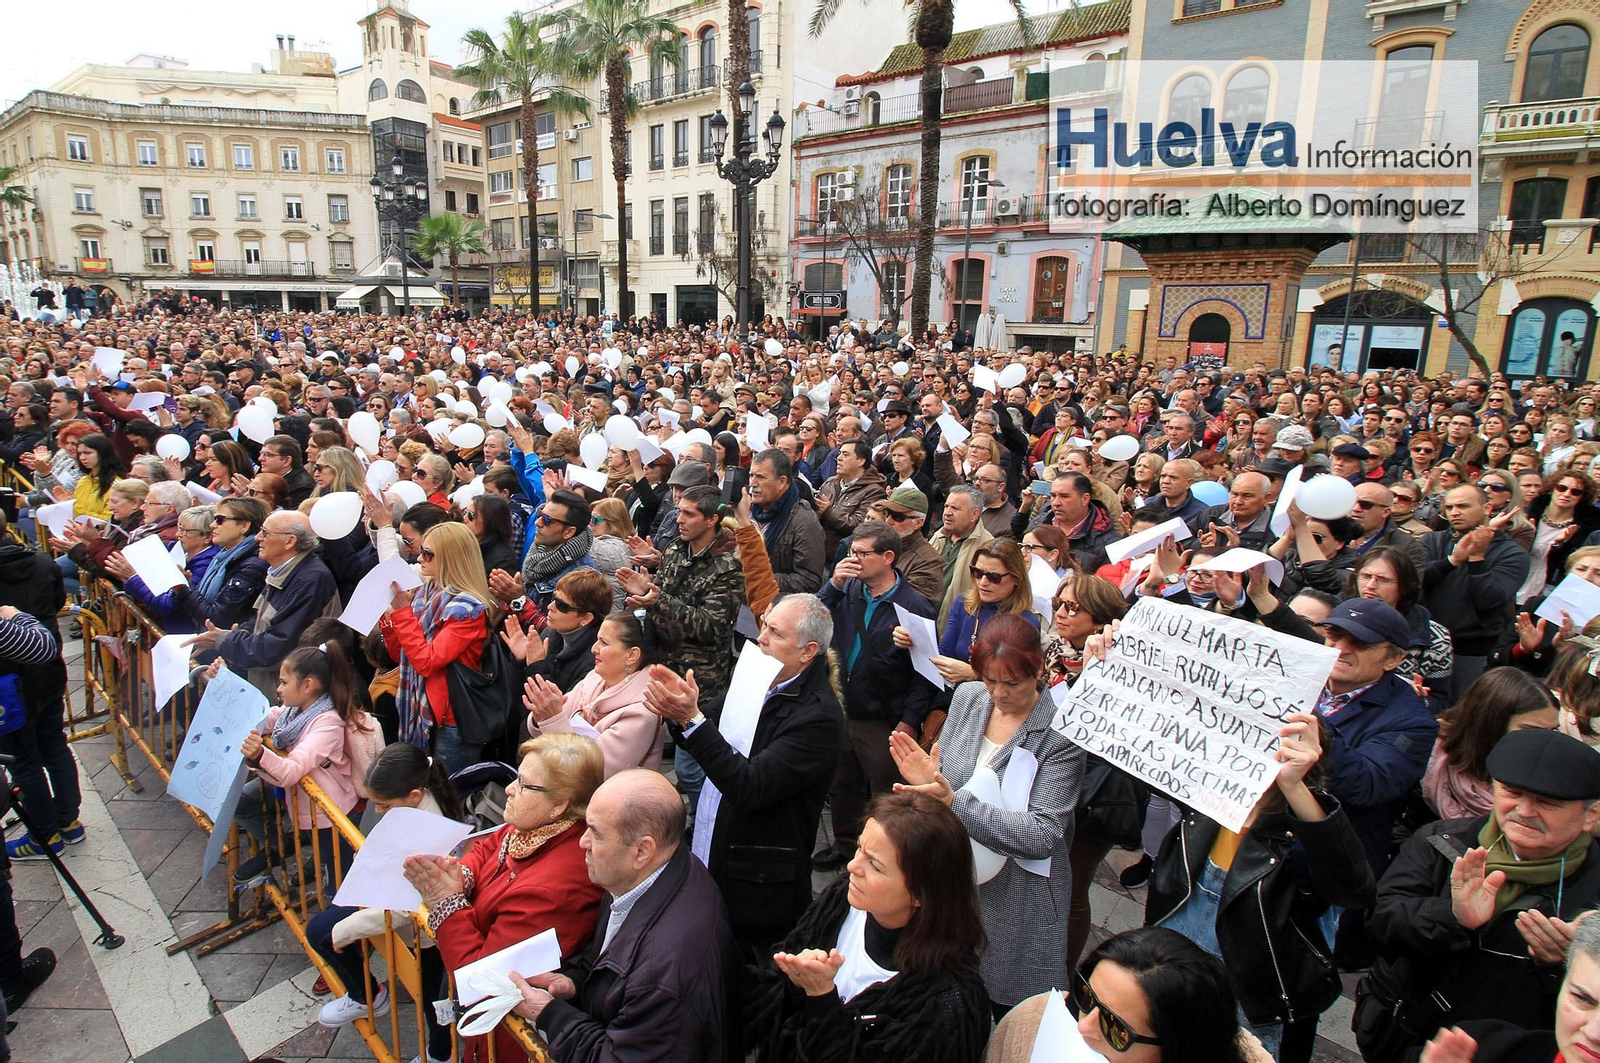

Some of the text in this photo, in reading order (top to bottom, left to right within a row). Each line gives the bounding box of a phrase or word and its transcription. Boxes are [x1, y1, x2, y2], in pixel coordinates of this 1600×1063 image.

[1058, 715, 1075, 731] Y
[1074, 724, 1191, 799] DESAPARECIDOS
[1068, 701, 1128, 742] TODAS
[1132, 735, 1166, 761] LAS
[1218, 745, 1267, 782] POR
